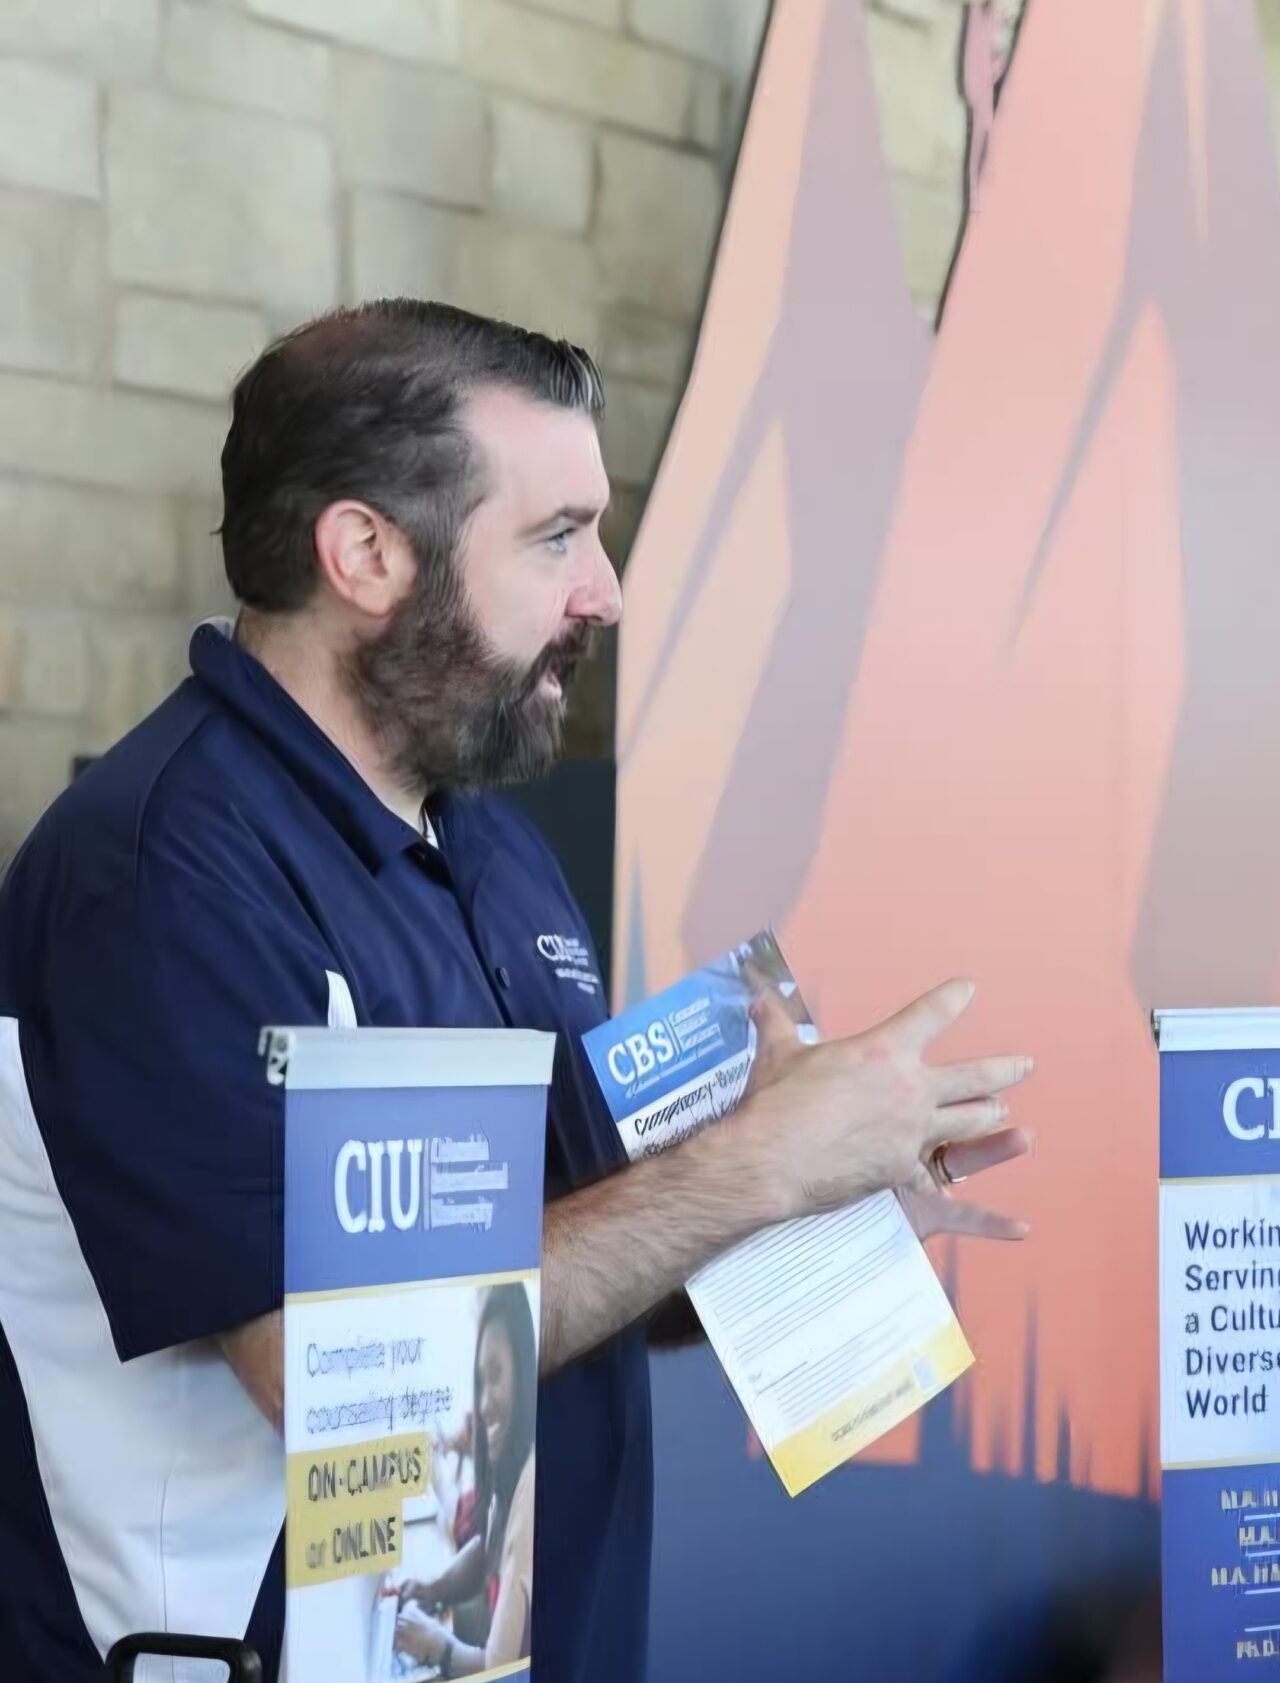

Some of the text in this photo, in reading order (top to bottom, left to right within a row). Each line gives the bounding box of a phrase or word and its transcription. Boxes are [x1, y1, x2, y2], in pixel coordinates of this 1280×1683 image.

[608, 1020, 675, 1085] CBS
[334, 1139, 423, 1233] CIU
[1184, 1312, 1200, 1335] a
[1186, 1383, 1268, 1418] World
[307, 1447, 422, 1502] ON-CAMPUS
[333, 1516, 397, 1563] ONLINE
